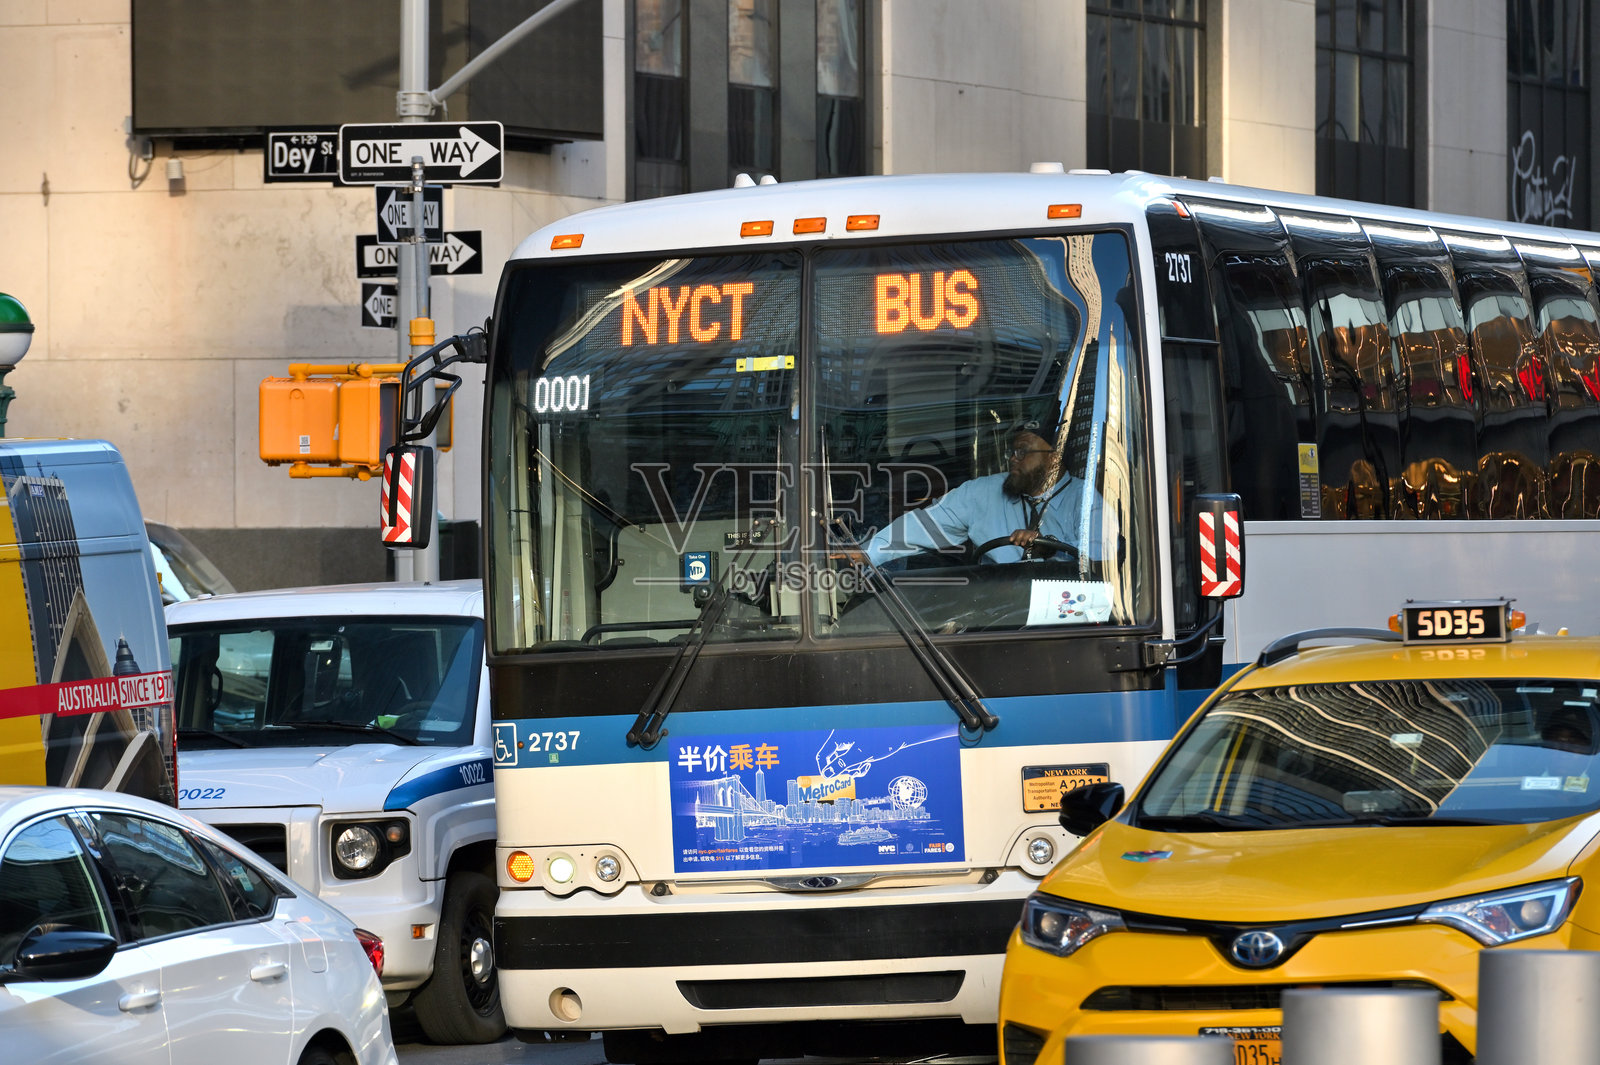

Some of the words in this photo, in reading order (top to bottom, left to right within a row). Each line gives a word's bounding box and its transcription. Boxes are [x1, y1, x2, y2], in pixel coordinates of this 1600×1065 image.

[274, 141, 316, 174] Dey
[321, 141, 333, 155] St
[356, 142, 402, 165] ONE
[430, 141, 480, 163] WAY
[387, 204, 407, 226] ONE
[423, 204, 435, 226] AY
[374, 247, 398, 264] ON
[1165, 252, 1192, 283] 2737
[372, 297, 393, 314] ONE
[621, 282, 754, 346] NYCT
[875, 270, 979, 334] BUS
[534, 374, 590, 413] 0001
[58, 682, 119, 712] AUSTRALIA
[120, 678, 150, 704] SINCE
[528, 730, 580, 752] 2737
[677, 742, 780, 773] 半价乘车
[460, 763, 486, 784] 10022
[1044, 769, 1064, 777] NEW
[1066, 768, 1088, 776] YORK
[179, 787, 226, 801] 0022
[798, 776, 852, 802] MetroCard
[878, 845, 896, 853] NYC
